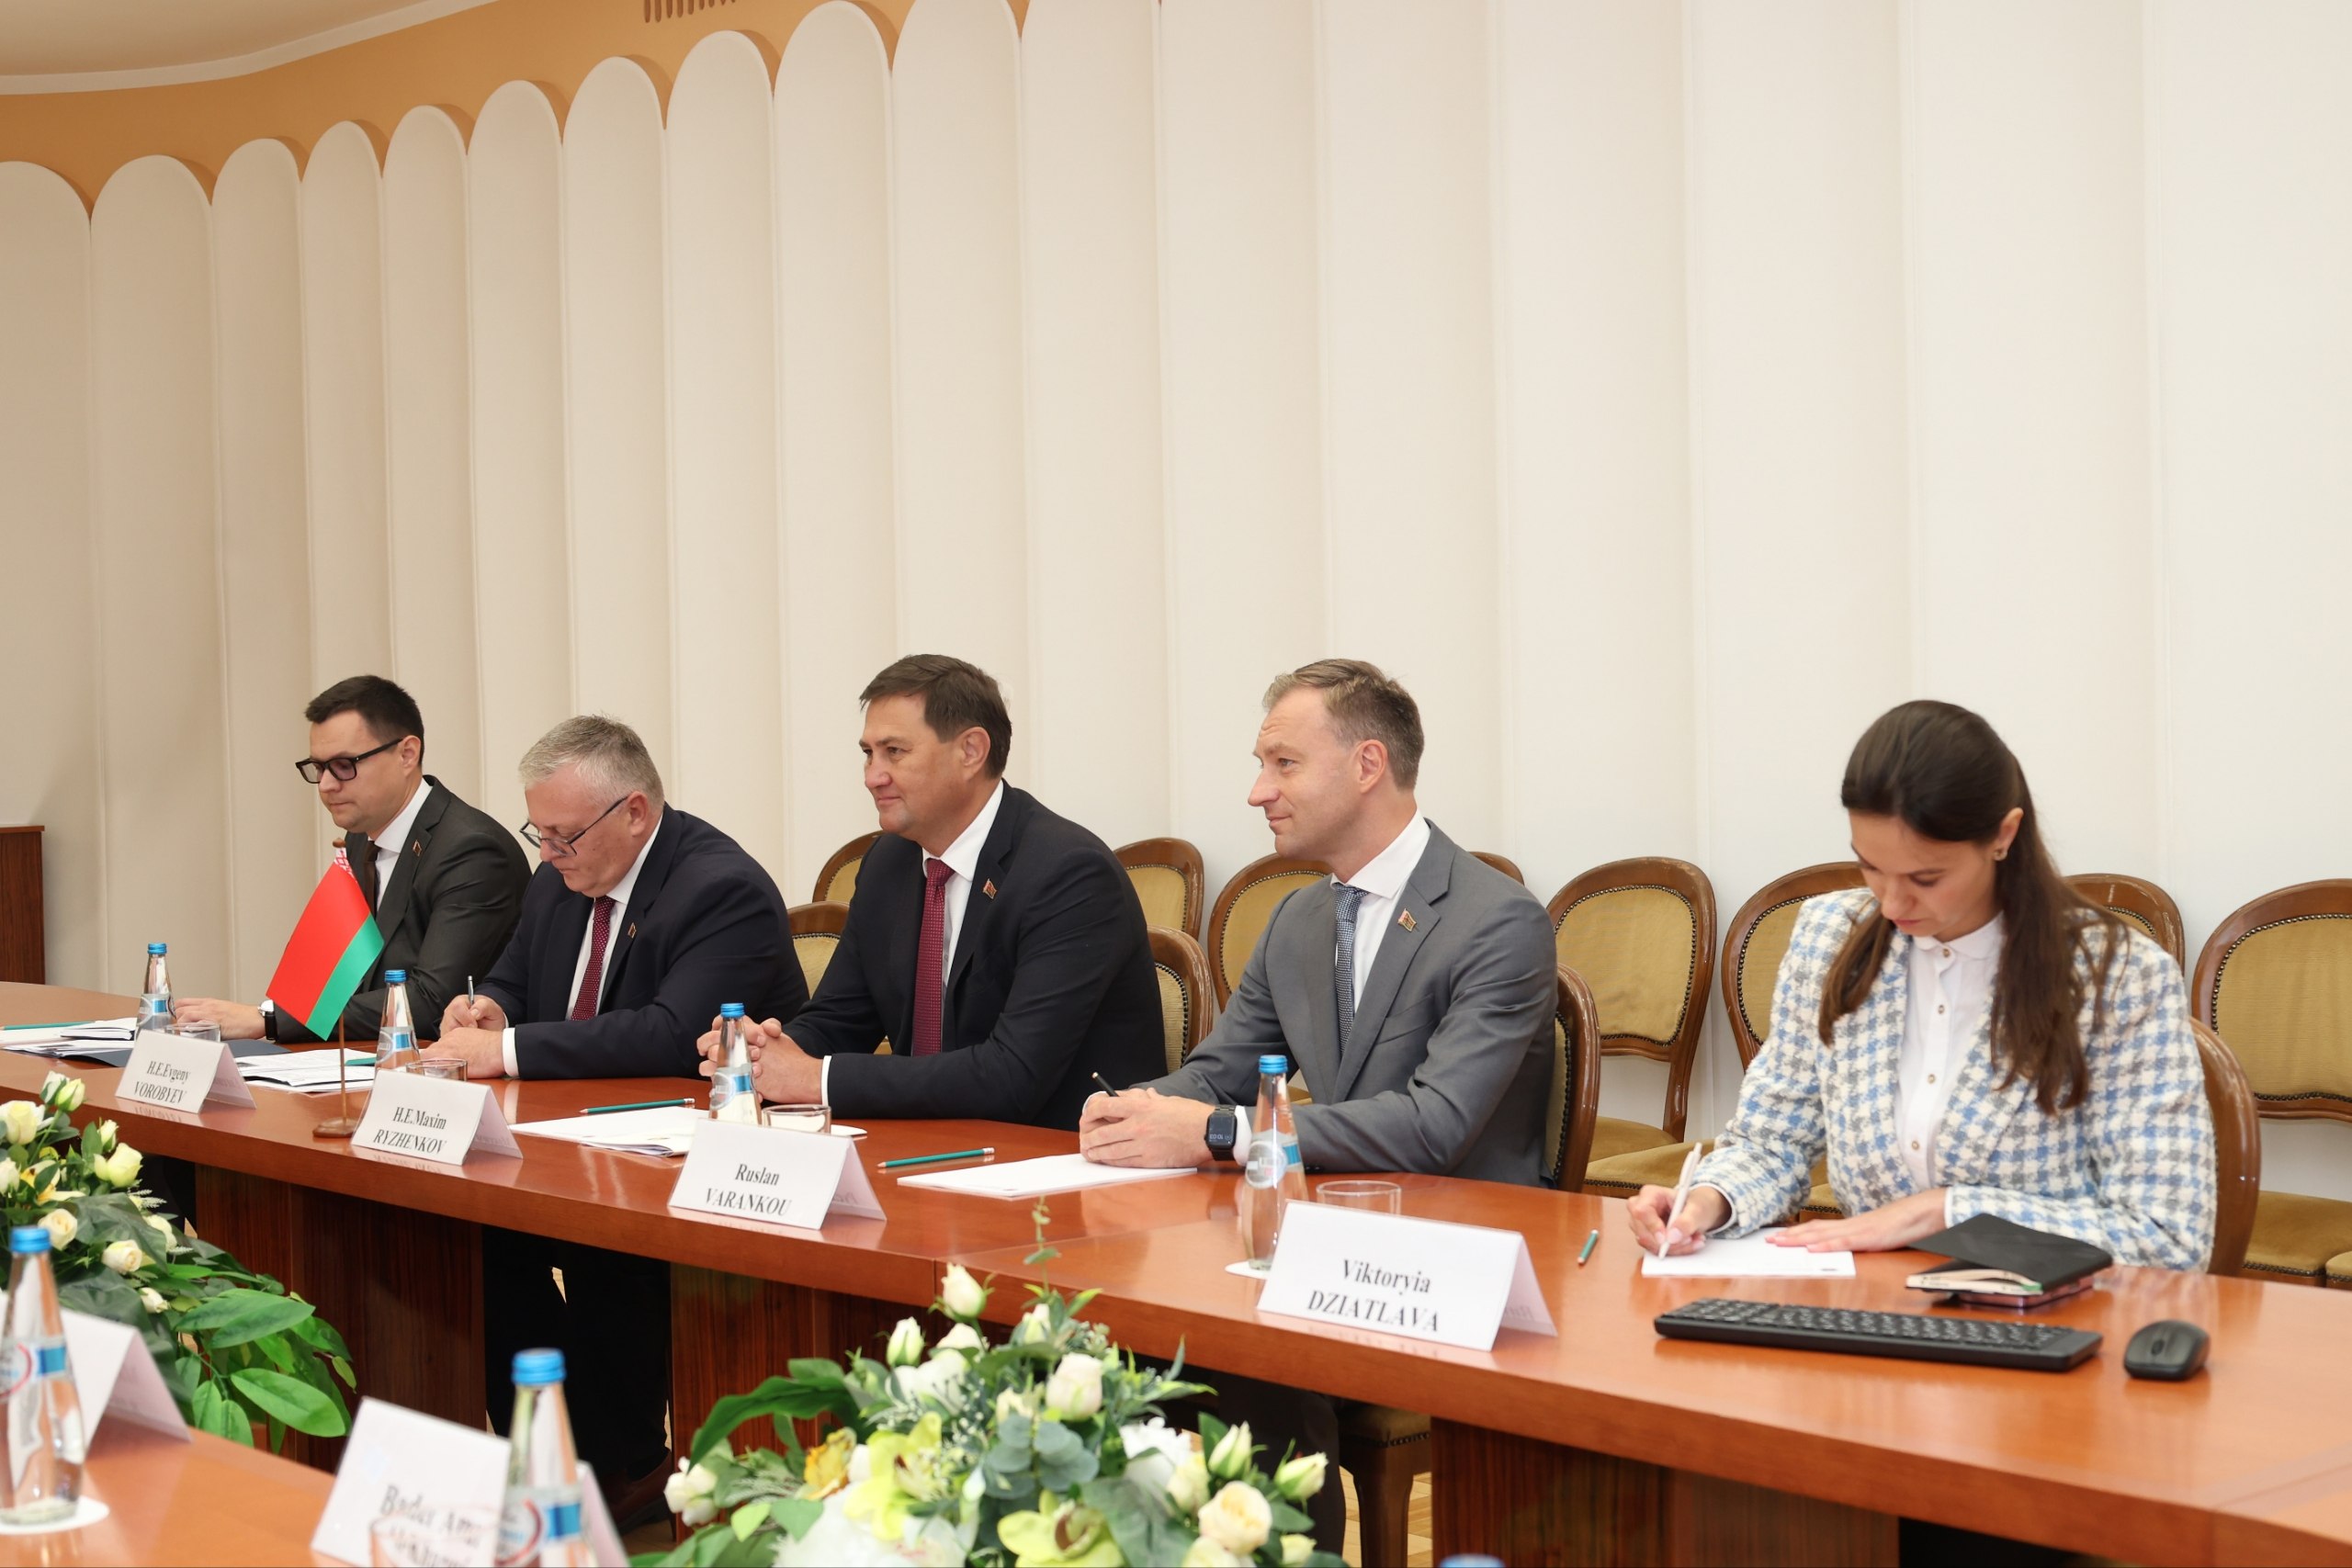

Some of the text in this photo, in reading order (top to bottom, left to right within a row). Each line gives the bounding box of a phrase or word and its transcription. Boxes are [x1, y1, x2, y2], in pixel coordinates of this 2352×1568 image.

[133, 1080, 187, 1104] VOROBYEV
[392, 1106, 447, 1130] H.E.Maxim
[372, 1128, 447, 1155] RYZHENKOV
[734, 1163, 780, 1186] Ruslan
[704, 1187, 792, 1217] VARANKOU
[1342, 1258, 1431, 1296] Viktoryia
[1306, 1290, 1440, 1333] DZIATLAVA
